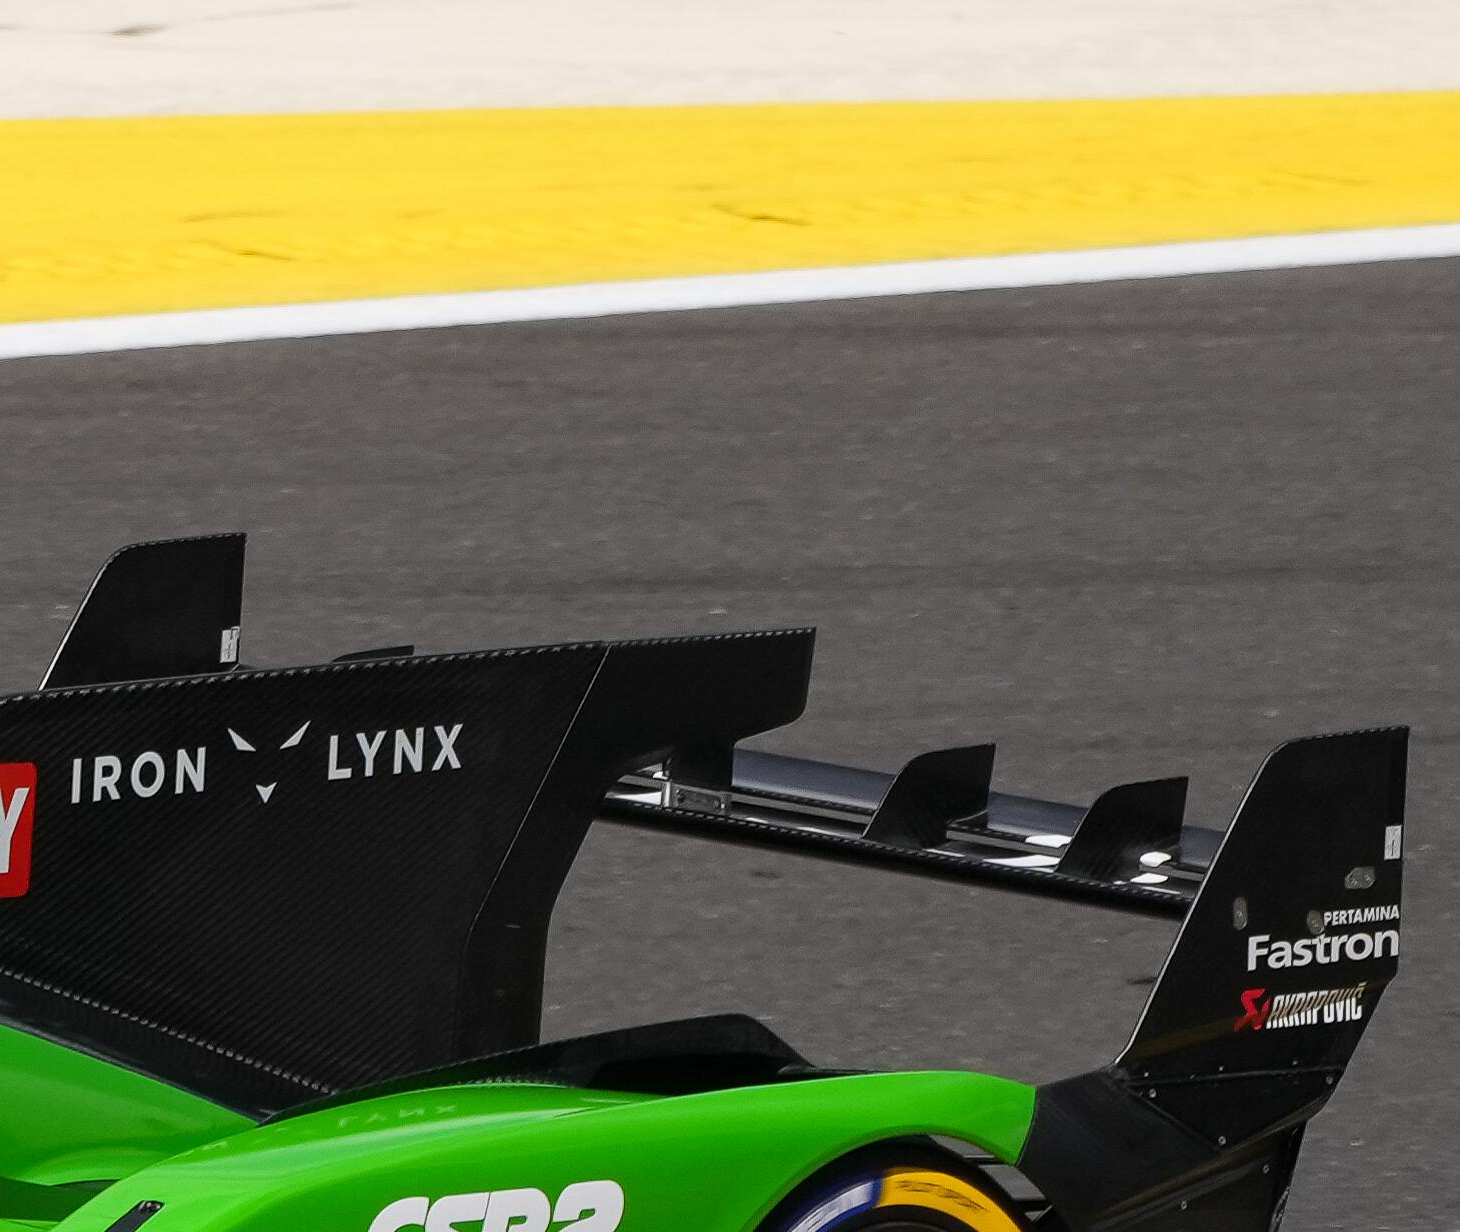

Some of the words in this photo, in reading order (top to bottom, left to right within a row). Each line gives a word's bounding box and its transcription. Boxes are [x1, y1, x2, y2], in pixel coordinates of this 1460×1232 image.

[71, 746, 207, 804] IRON
[328, 723, 464, 781] LYNX
[1324, 904, 1400, 927] PERTAMINA
[1247, 929, 1400, 972] Fastron
